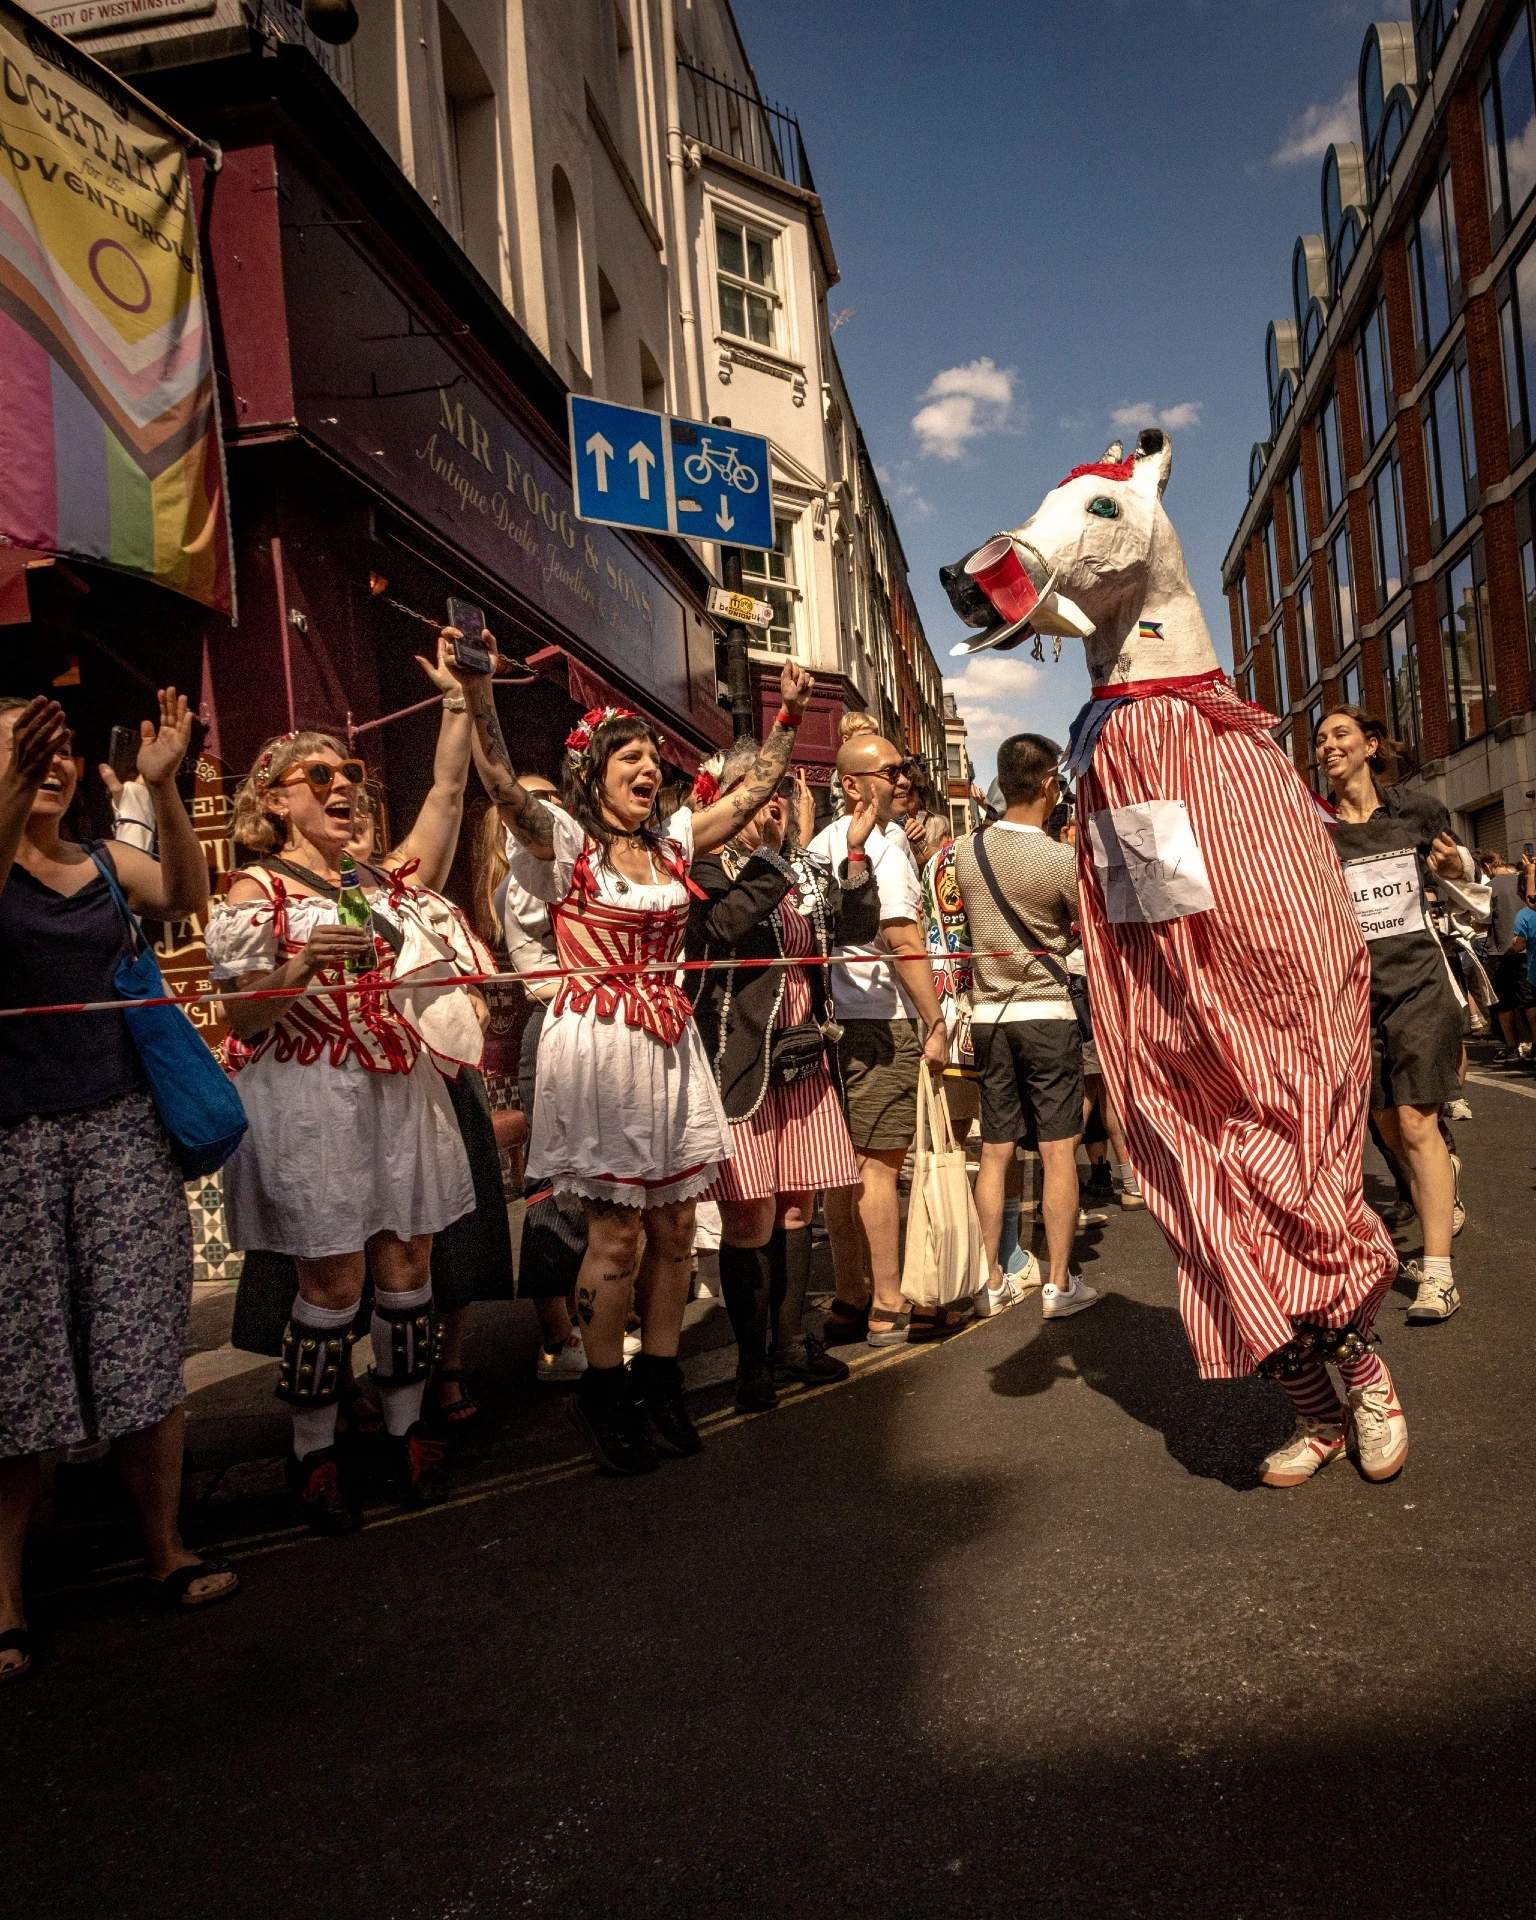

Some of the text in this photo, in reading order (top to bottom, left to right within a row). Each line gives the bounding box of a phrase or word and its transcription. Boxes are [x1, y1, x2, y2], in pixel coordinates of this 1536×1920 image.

[51, 9, 79, 29] CITY
[81, 9, 95, 22] OF
[3, 57, 187, 216] OCKTAILS
[76, 157, 125, 197] for the
[415, 434, 488, 514] Antique
[437, 382, 494, 474] MR
[503, 449, 575, 549] FOGG
[584, 534, 599, 574] &
[606, 556, 652, 622] SONS
[728, 610, 751, 620] UNION
[1373, 883, 1401, 899] ROT
[1406, 881, 1413, 893] 1
[1361, 917, 1404, 933] Square
